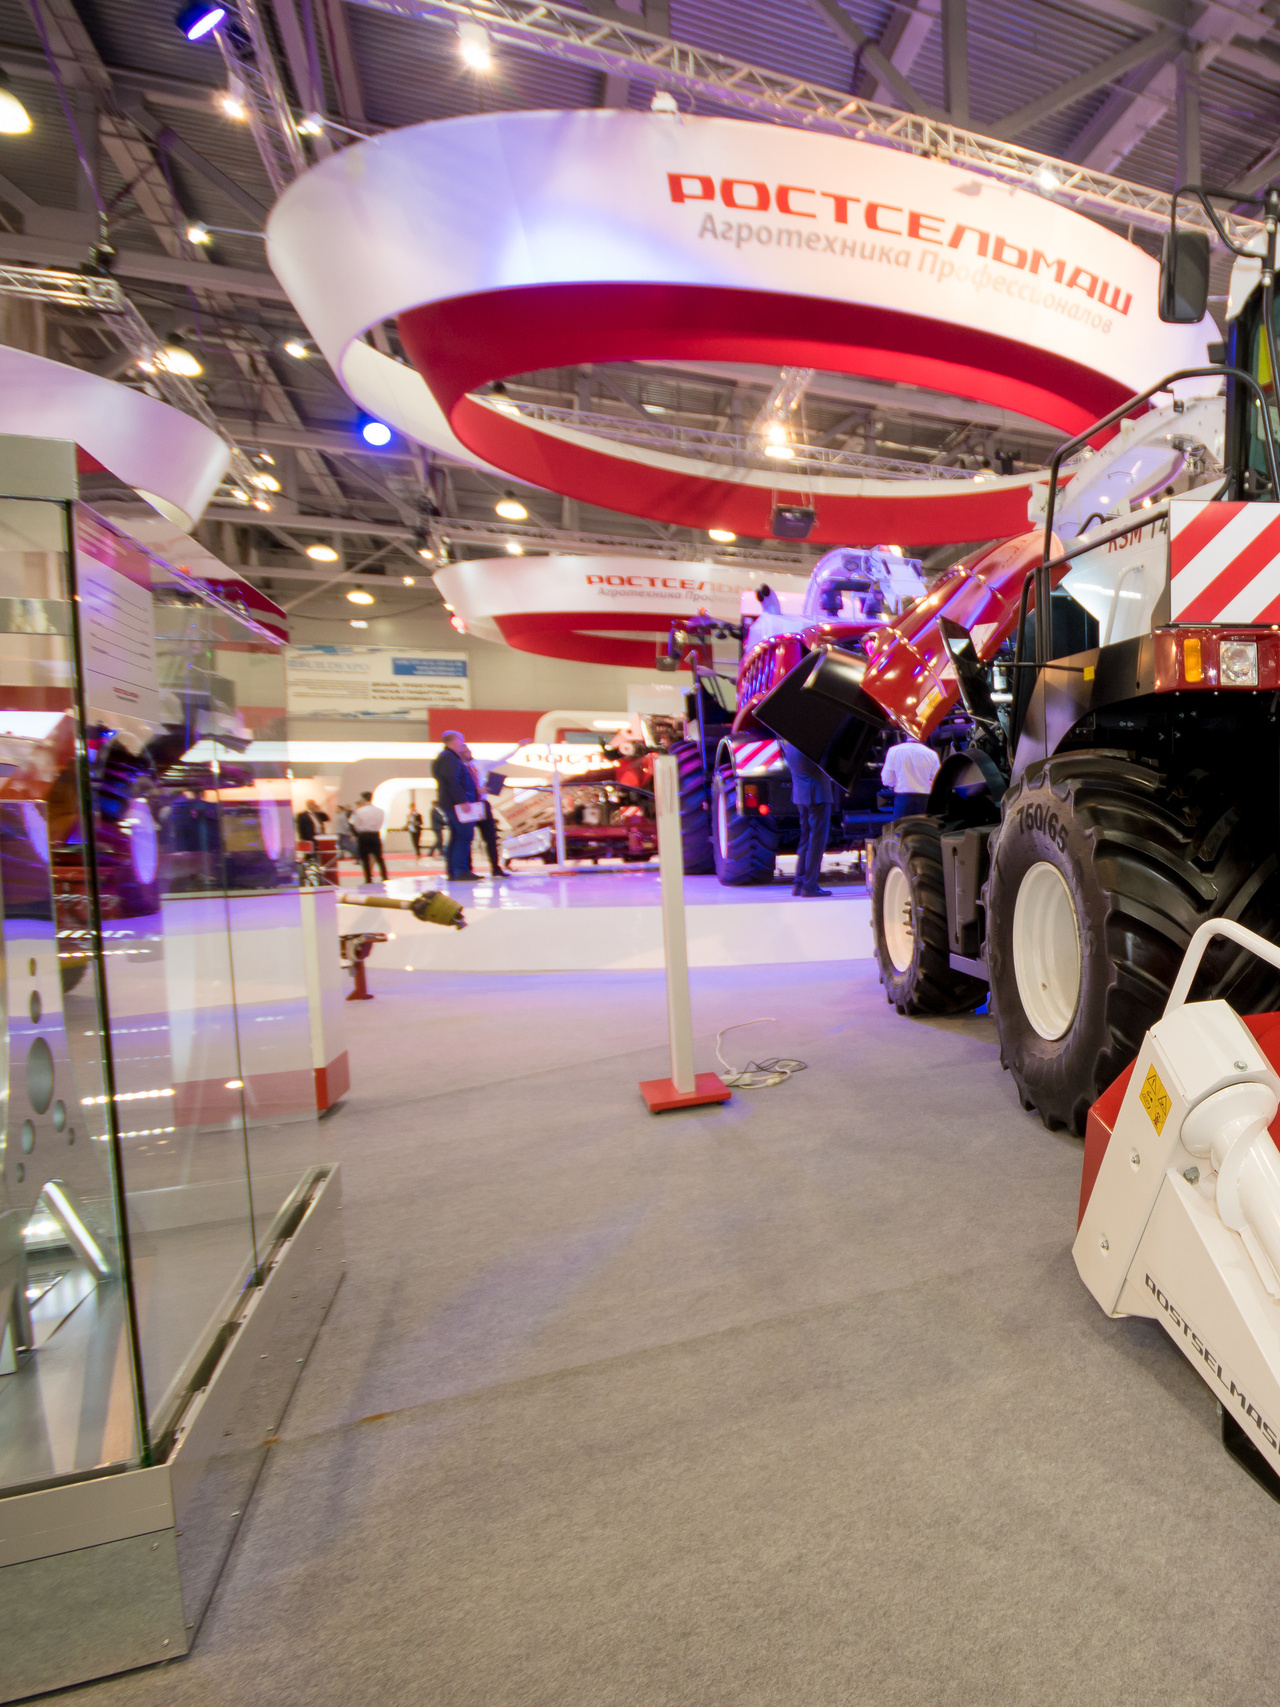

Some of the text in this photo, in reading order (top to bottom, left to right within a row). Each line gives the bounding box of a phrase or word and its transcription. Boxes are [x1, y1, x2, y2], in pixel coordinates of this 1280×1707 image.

[667, 172, 1133, 317] РОСТСЕЛЬМАШ
[699, 212, 1114, 334] Агротехника Профессионалов
[1016, 803, 1069, 853] 750/65
